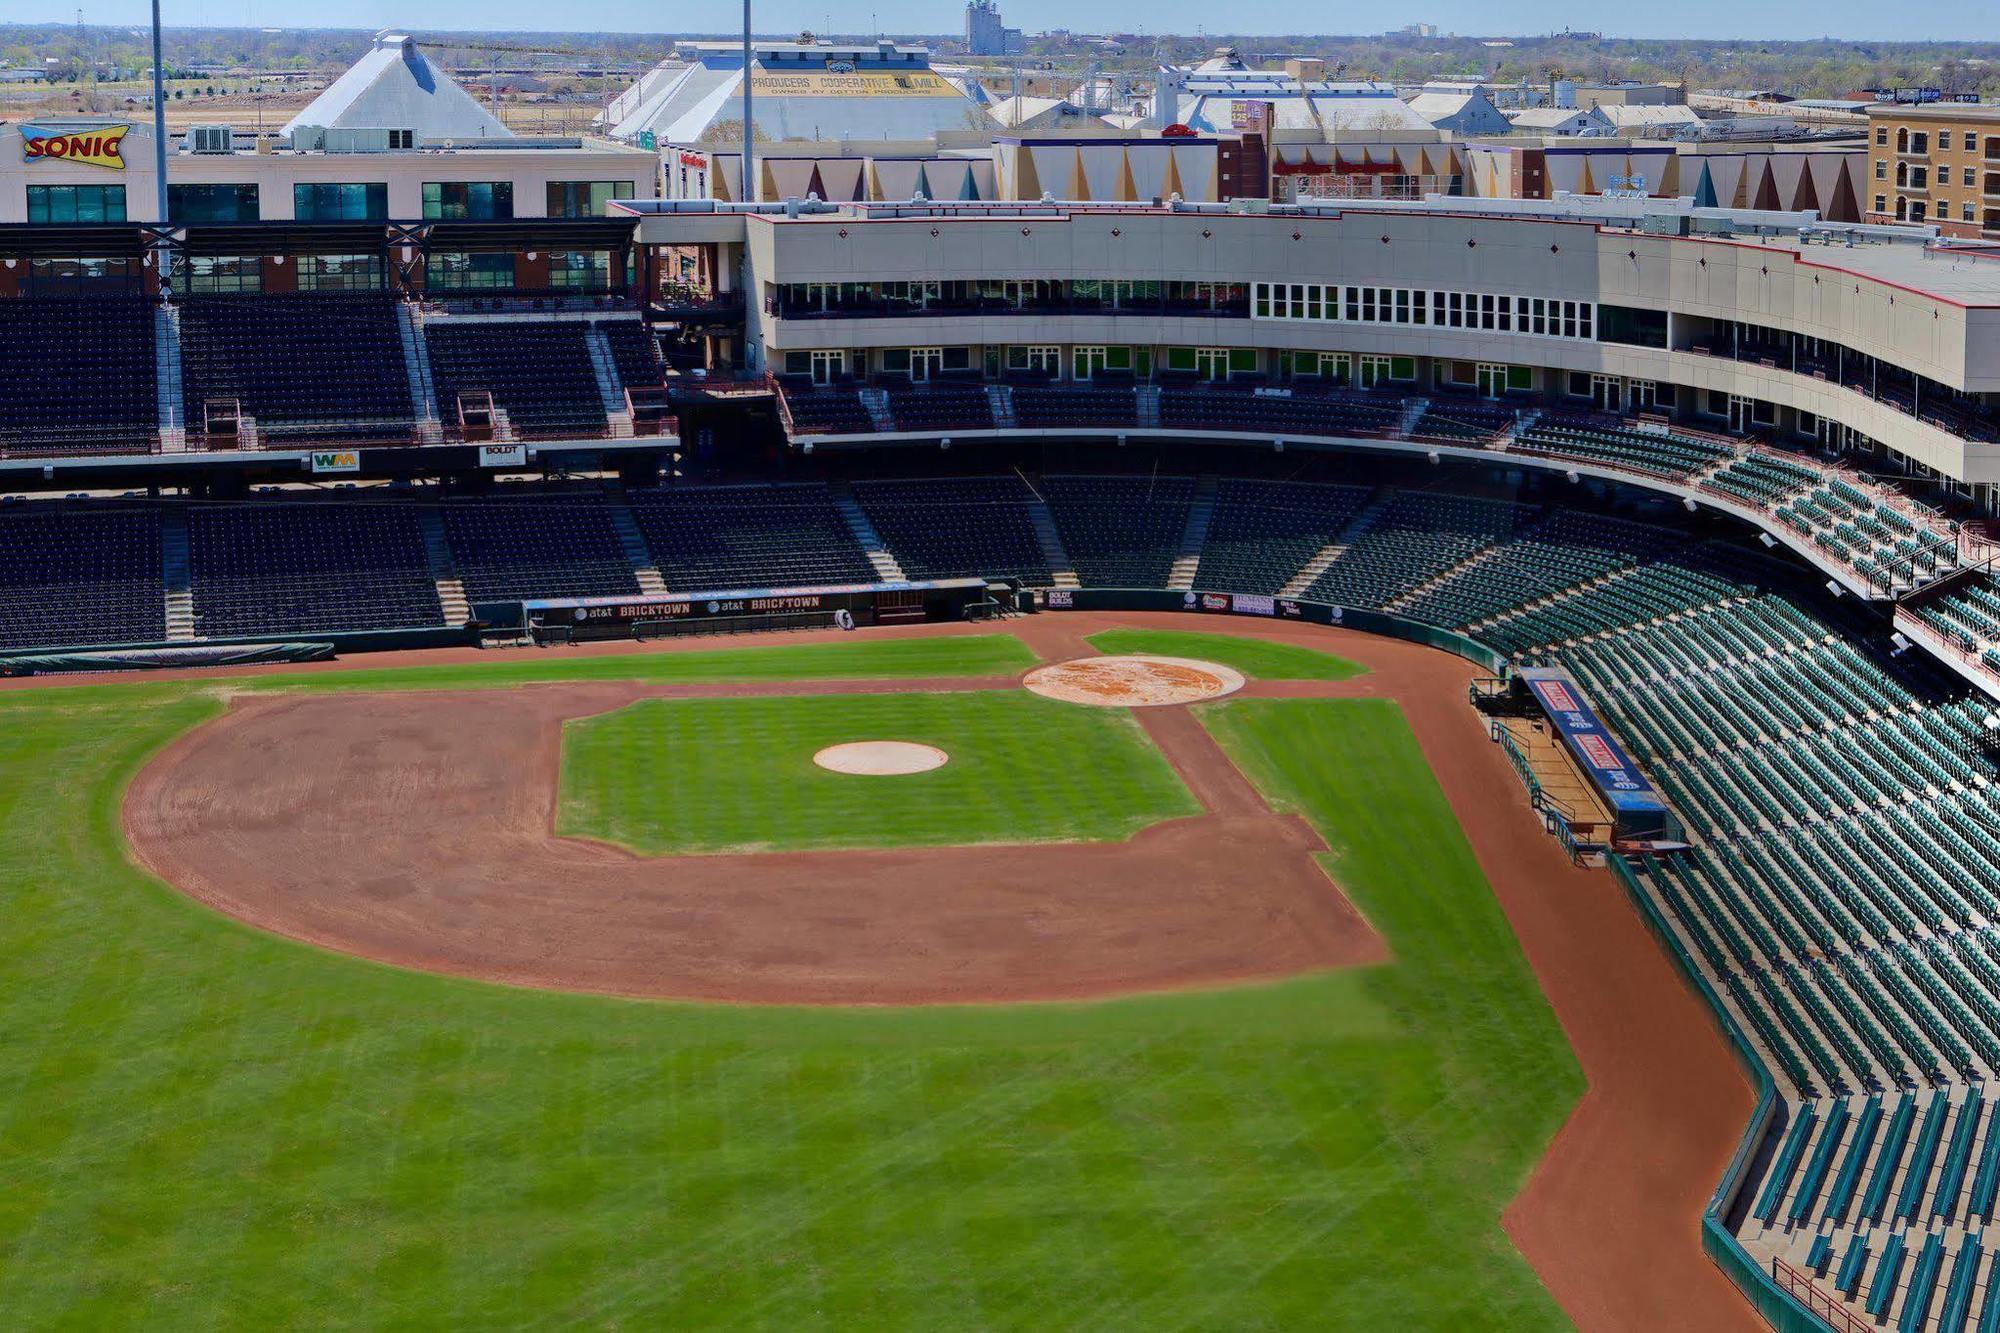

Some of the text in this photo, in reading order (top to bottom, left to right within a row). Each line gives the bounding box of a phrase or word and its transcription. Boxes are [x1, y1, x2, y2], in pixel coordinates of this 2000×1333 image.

[752, 77, 810, 88] PRODUCERS
[820, 77, 888, 88] COOPERATIVE
[27, 136, 121, 157] SONIC
[485, 445, 518, 455] BOLDT
[314, 453, 356, 466] WM
[721, 601, 744, 611] at&t
[751, 597, 820, 610] BRICKTOWN
[589, 606, 613, 618] at&t
[620, 603, 690, 617] BRICKTOWN
